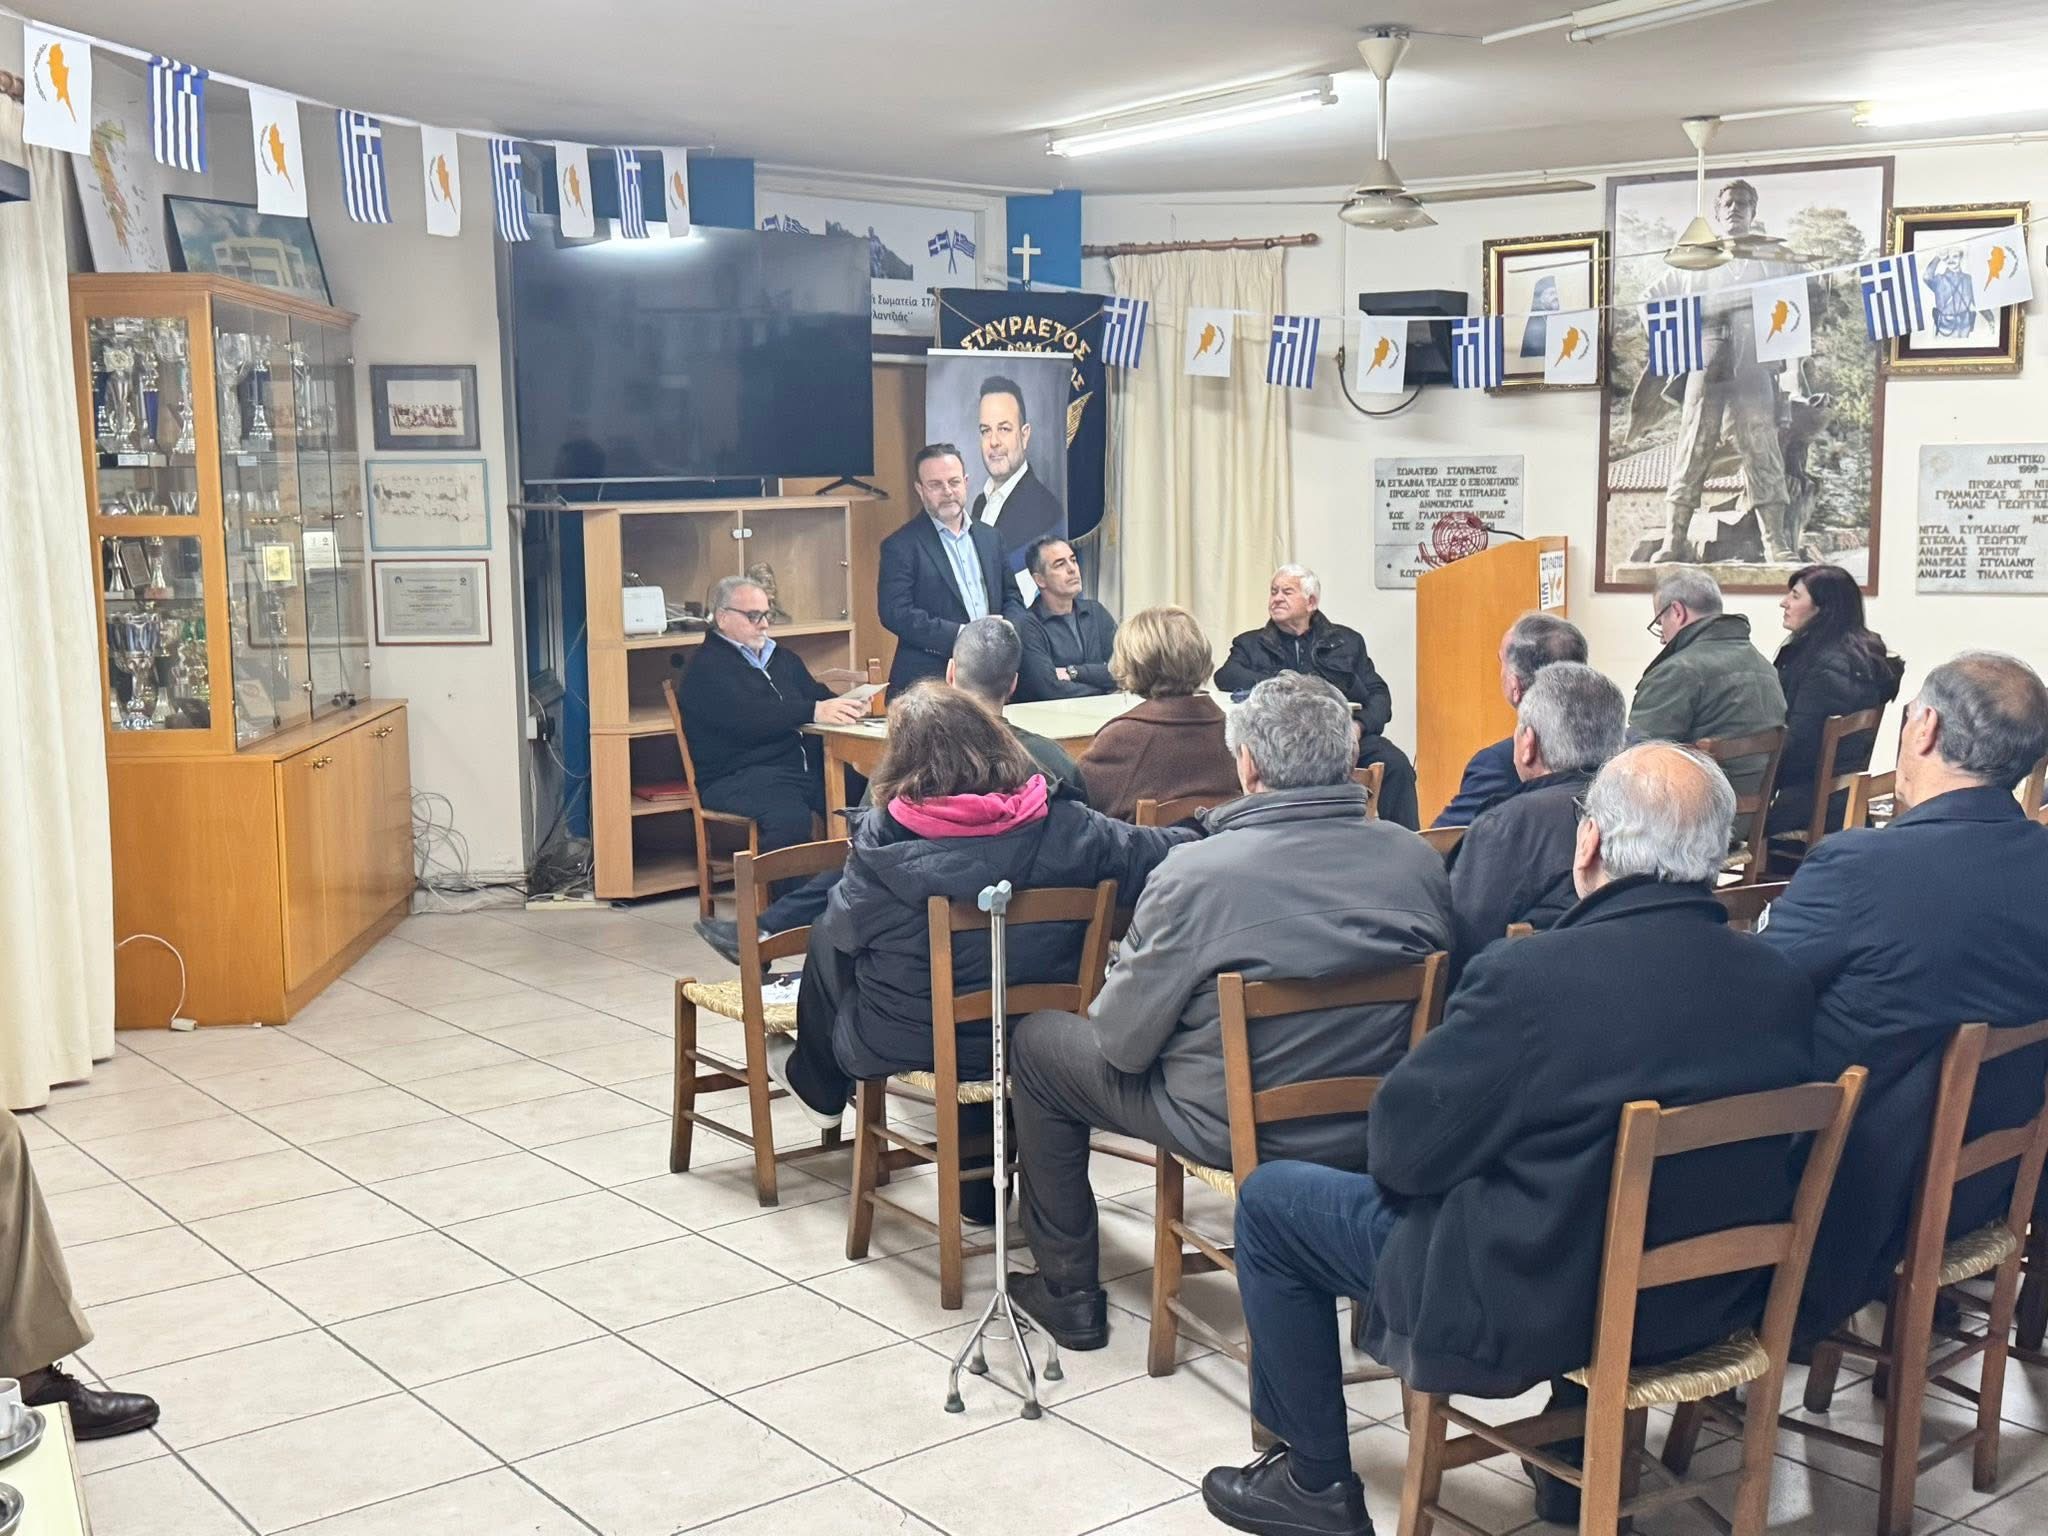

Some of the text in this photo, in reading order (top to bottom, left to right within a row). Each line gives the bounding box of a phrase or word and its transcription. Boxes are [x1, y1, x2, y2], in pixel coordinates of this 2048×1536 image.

[960, 315, 1092, 362] ΣΤΑΥΡΑΕΤΟΣ
[1987, 454, 2046, 465] ΔΙΟΙΚΗΤΙΚΟ
[1397, 466, 1497, 476] ΣΩΜΑΤΕΙΟ ΣΤΑΥΡΑΕΤΟΣ
[1968, 479, 2022, 489] ΠΡΟΕΔΡΟΣ
[1389, 489, 1430, 498] ΠΡΟΕΔΡΟΣ
[1459, 488, 1507, 497] ΚΥΠΡΙΑΚΗΣ
[1935, 490, 2006, 500] ΓΡΑΜΜΑΤΕΑΣ
[1947, 500, 1985, 509] ΤΑΜΙΑΣ
[1918, 546, 1968, 556] ΑΝΔΡΕΑΣ
[1918, 558, 2035, 567] ΑΝΔΡΕΑΣ ΣΤΥΛΙΑΝΟΥ
[1918, 569, 1966, 579] ΑΝΔΡΕΑΣ
